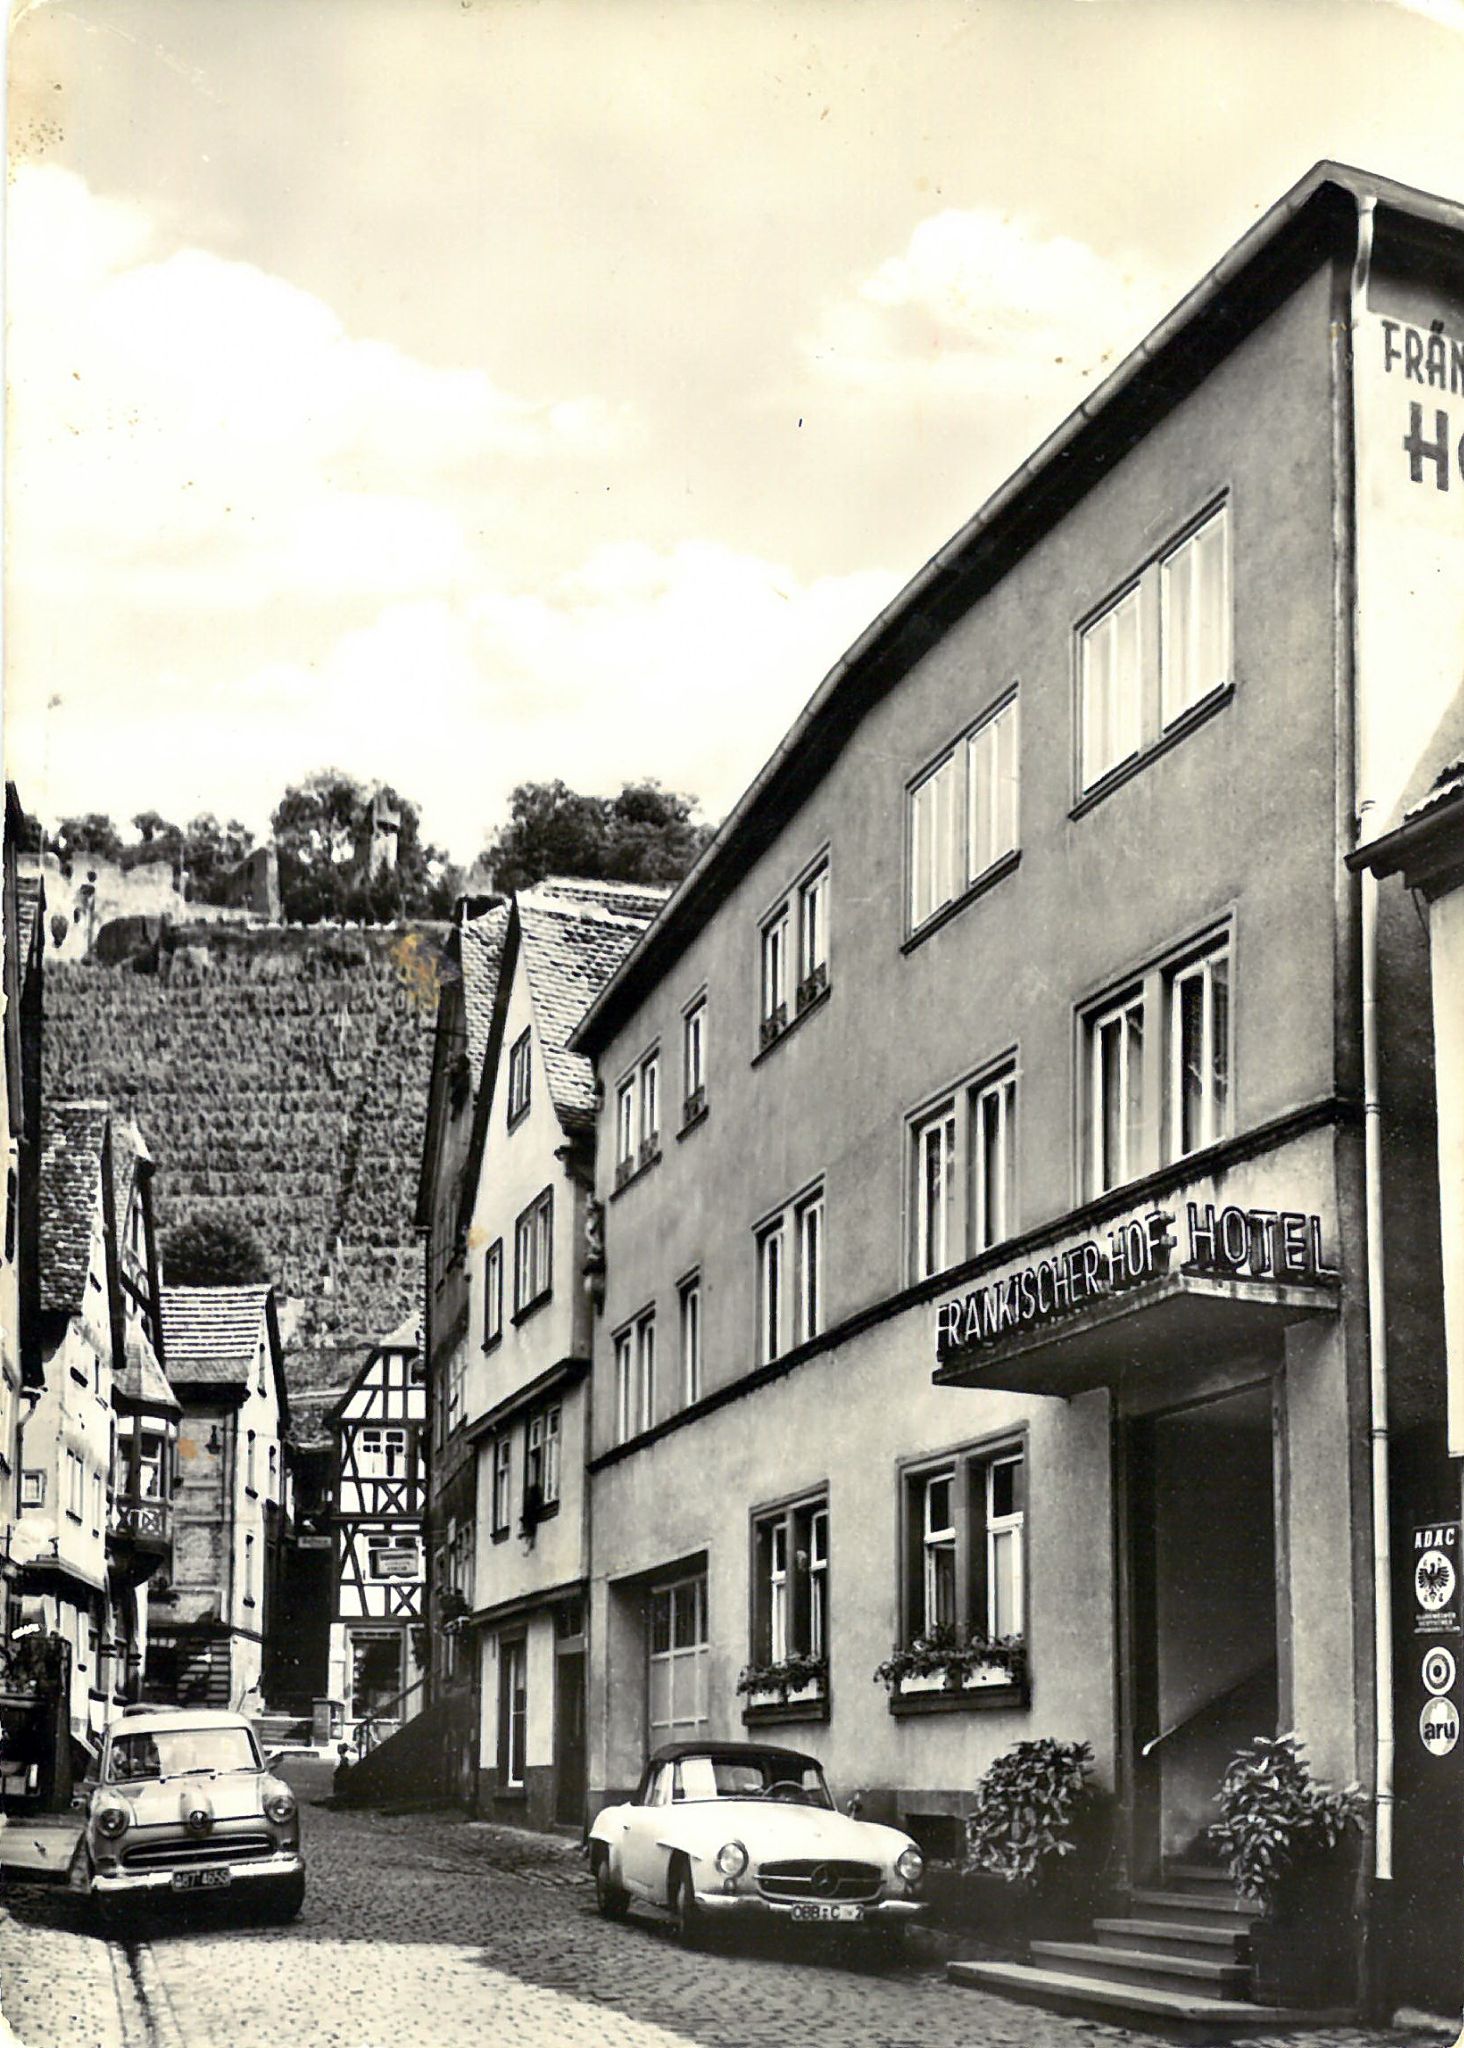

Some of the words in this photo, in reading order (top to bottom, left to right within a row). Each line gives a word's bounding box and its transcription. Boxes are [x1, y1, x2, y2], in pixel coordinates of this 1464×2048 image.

[1404, 401, 1464, 491] H
[1108, 1211, 1176, 1288] HOF
[1187, 1202, 1340, 1277] HOTEL
[1415, 1528, 1455, 1548] ADAC
